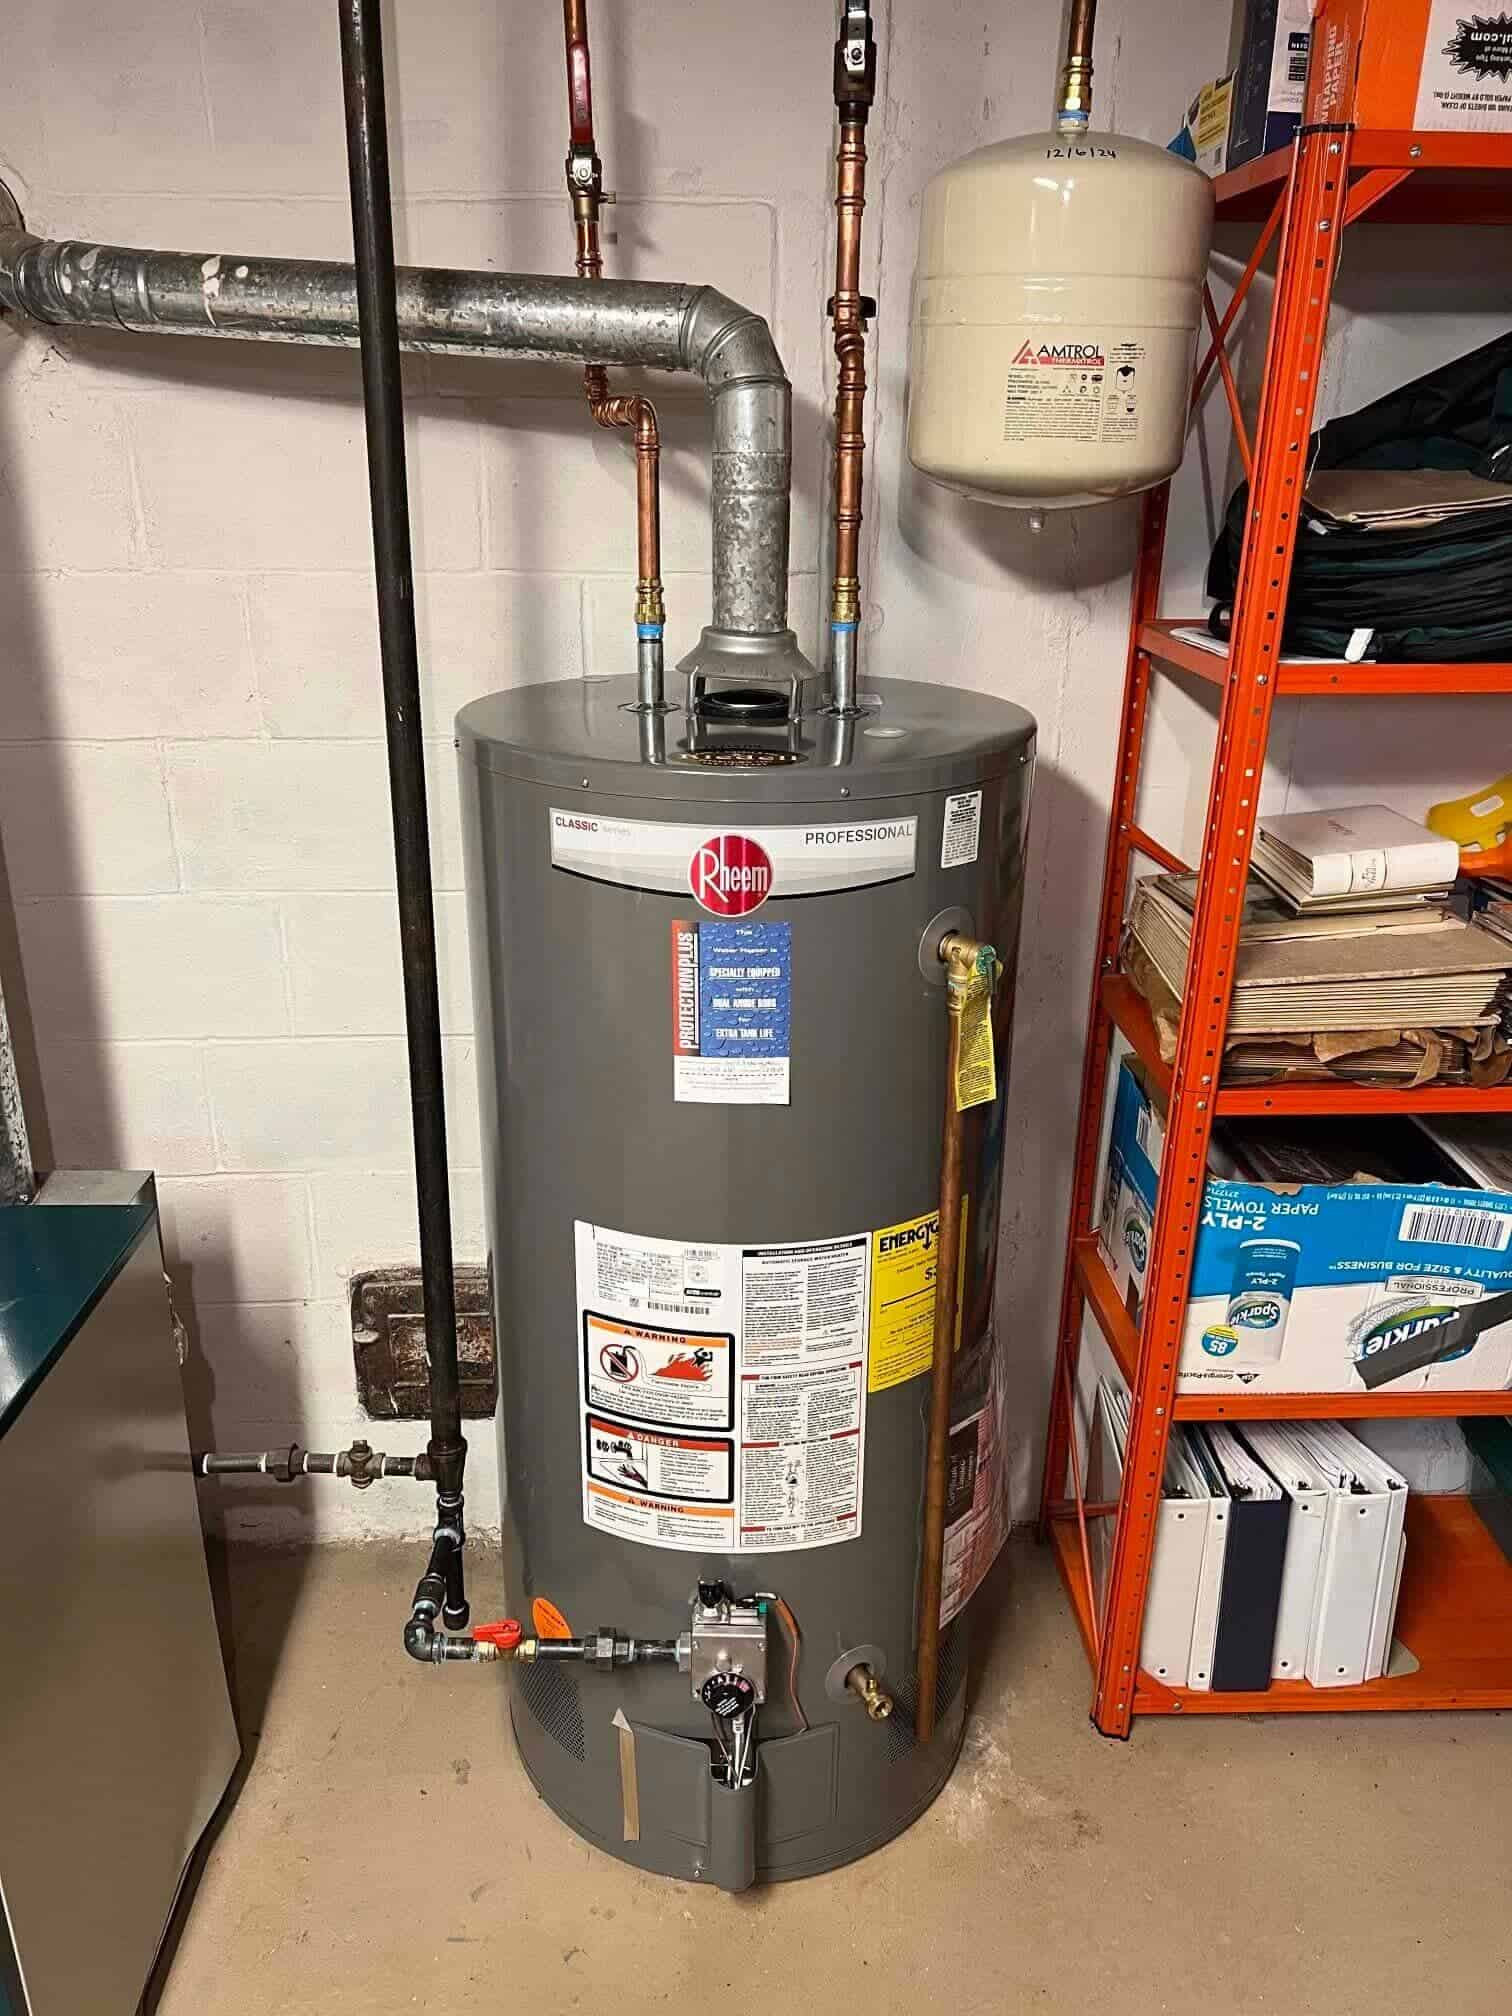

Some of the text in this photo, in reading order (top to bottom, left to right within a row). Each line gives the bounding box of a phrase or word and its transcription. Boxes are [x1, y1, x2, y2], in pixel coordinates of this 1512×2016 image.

[1046, 147, 1117, 159] 12/6/24
[1037, 344, 1104, 360] AMTROL
[555, 816, 598, 832] CLASSIC
[805, 823, 913, 845] PROFESSIONAL
[700, 836, 768, 903] Rheem
[709, 967, 781, 978] SPECIALLY EQUIPPED
[760, 1028, 774, 1039] LIFE
[1204, 1197, 1321, 1216] TOWELS PAPER
[1201, 1211, 1267, 1231] 2-PLY
[880, 1218, 939, 1251] ENERGYG
[1395, 1262, 1421, 1271] FOR
[1423, 1263, 1450, 1274] SIZE
[1393, 1281, 1475, 1296] PROFESSIONAL
[635, 1330, 687, 1344] WARNING
[1209, 1339, 1228, 1354] 85
[638, 1433, 680, 1447] DANGER
[639, 1499, 684, 1513] WARNING
